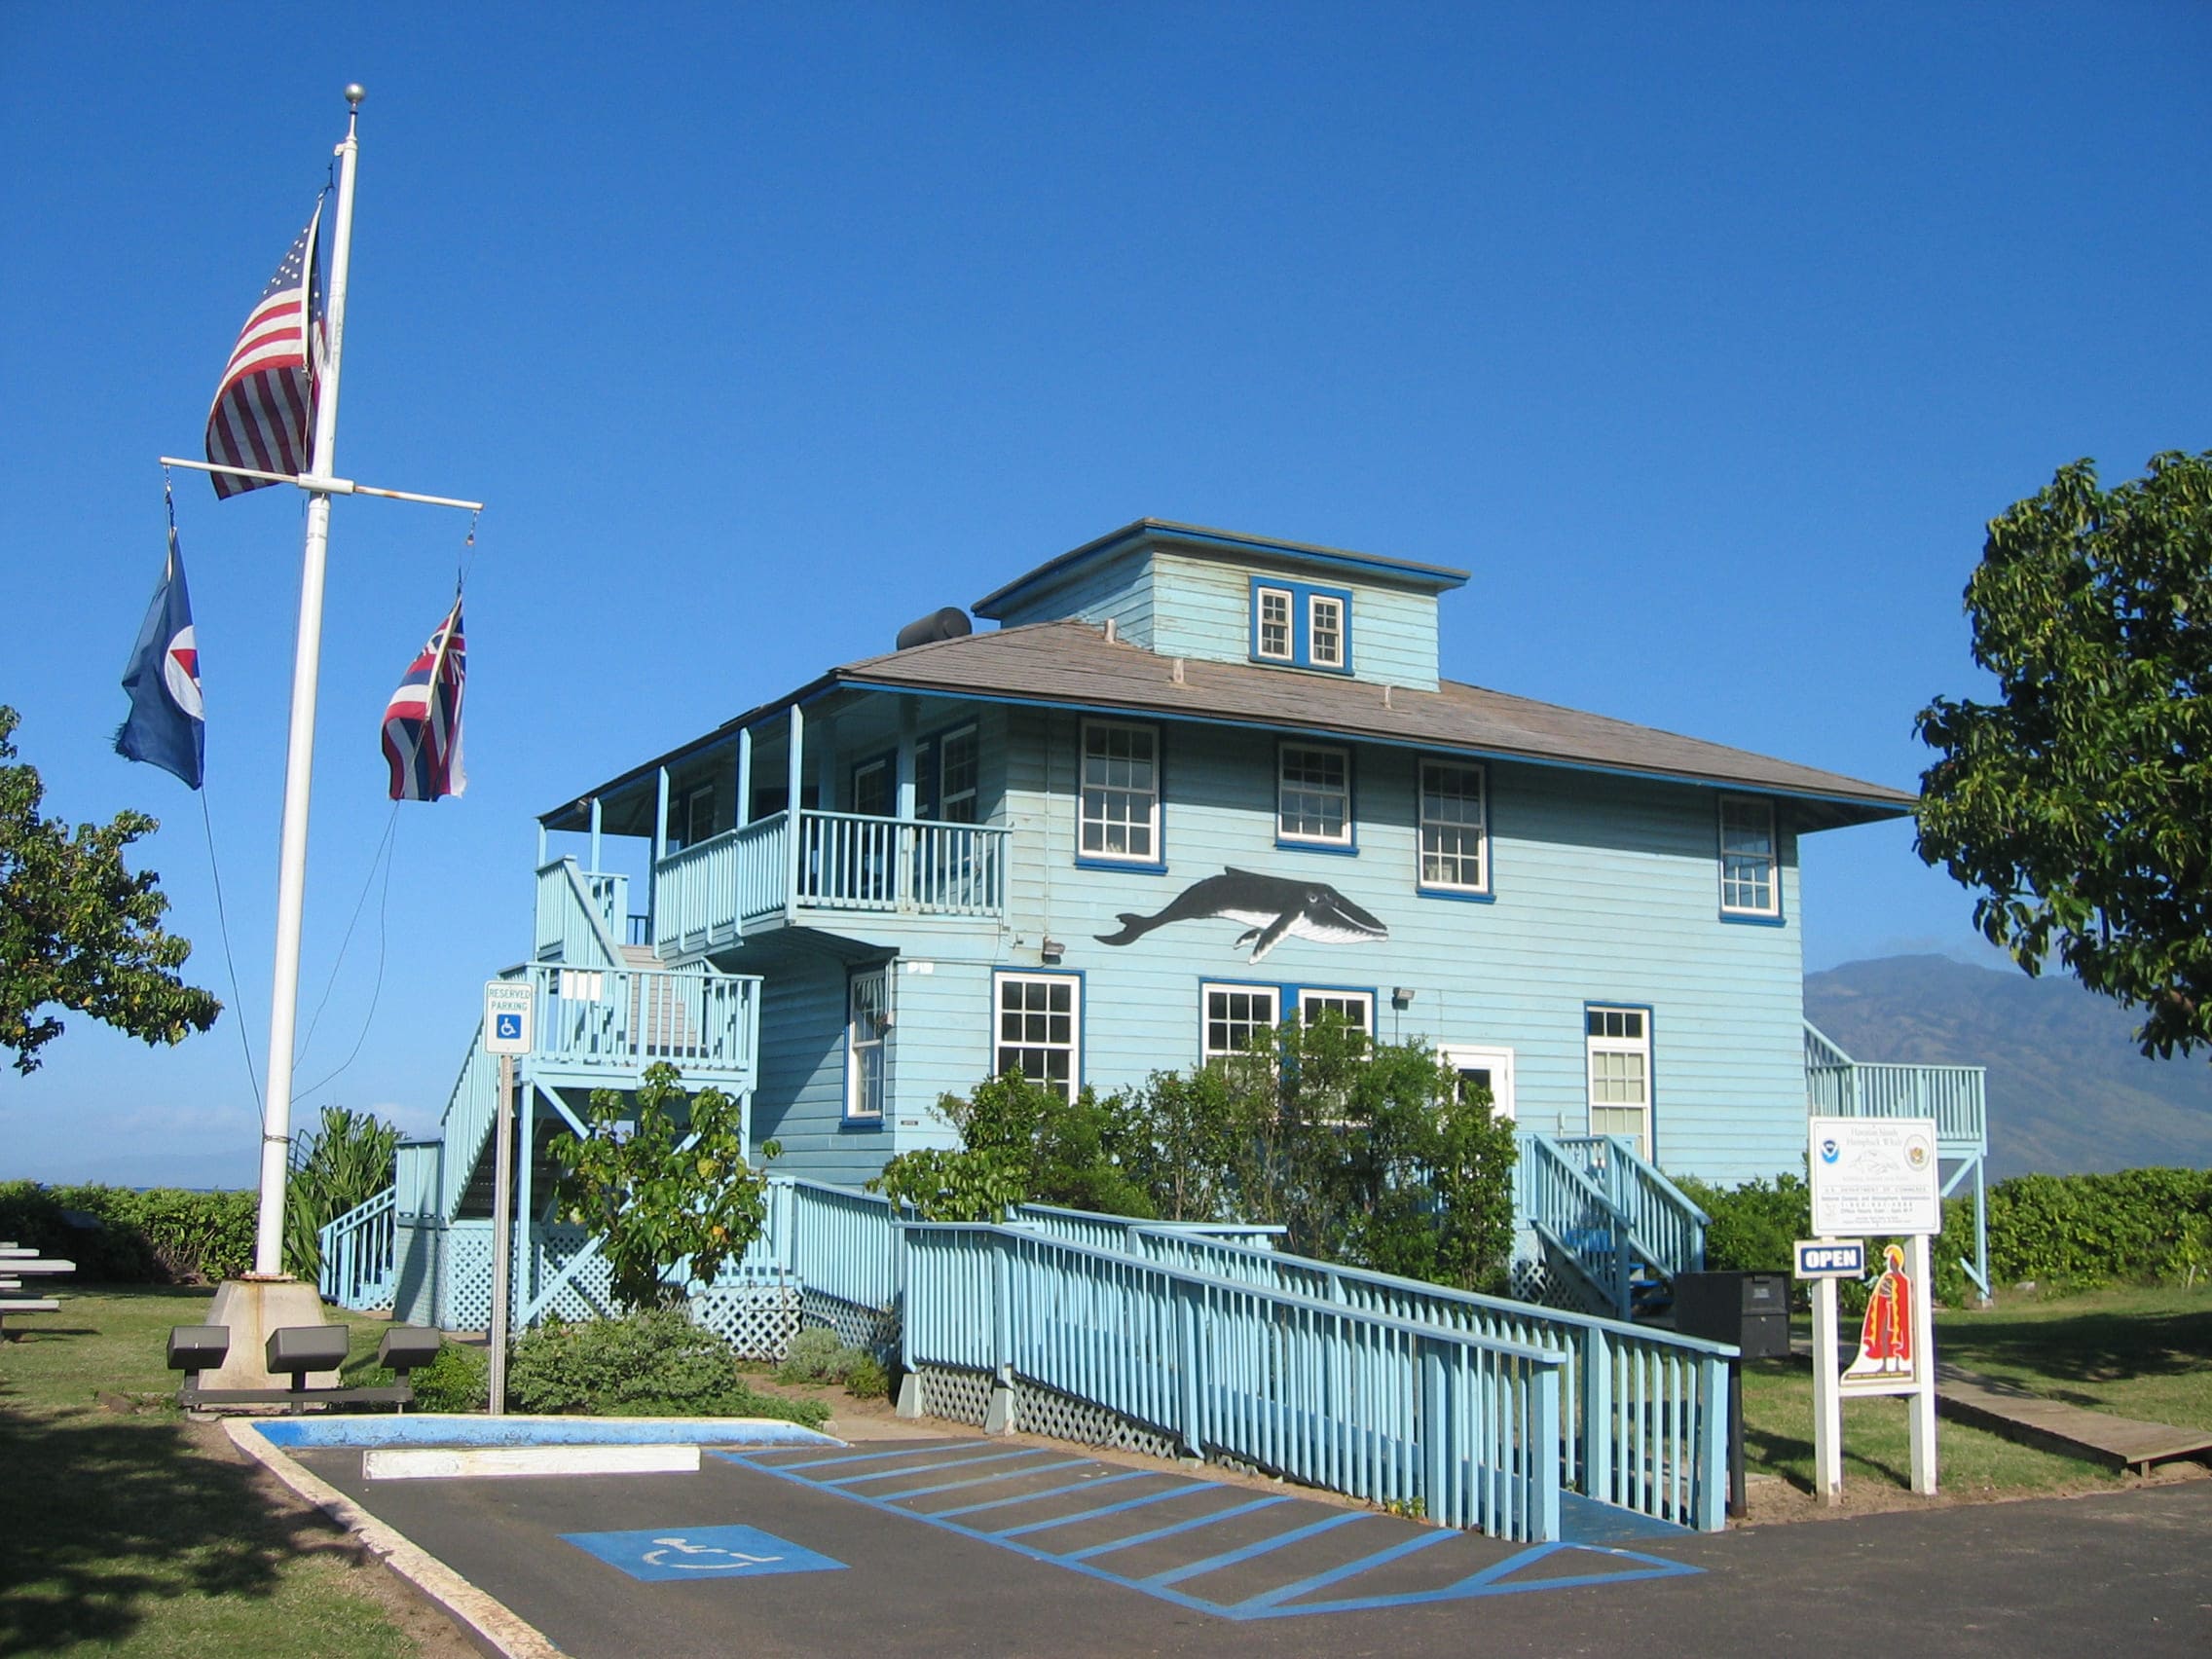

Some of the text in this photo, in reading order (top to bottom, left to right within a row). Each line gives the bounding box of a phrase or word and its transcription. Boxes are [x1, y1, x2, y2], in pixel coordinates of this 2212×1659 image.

[489, 988, 531, 1000] RESERVED
[491, 1001, 528, 1012] PARKING
[1805, 1249, 1857, 1269] OPEN
